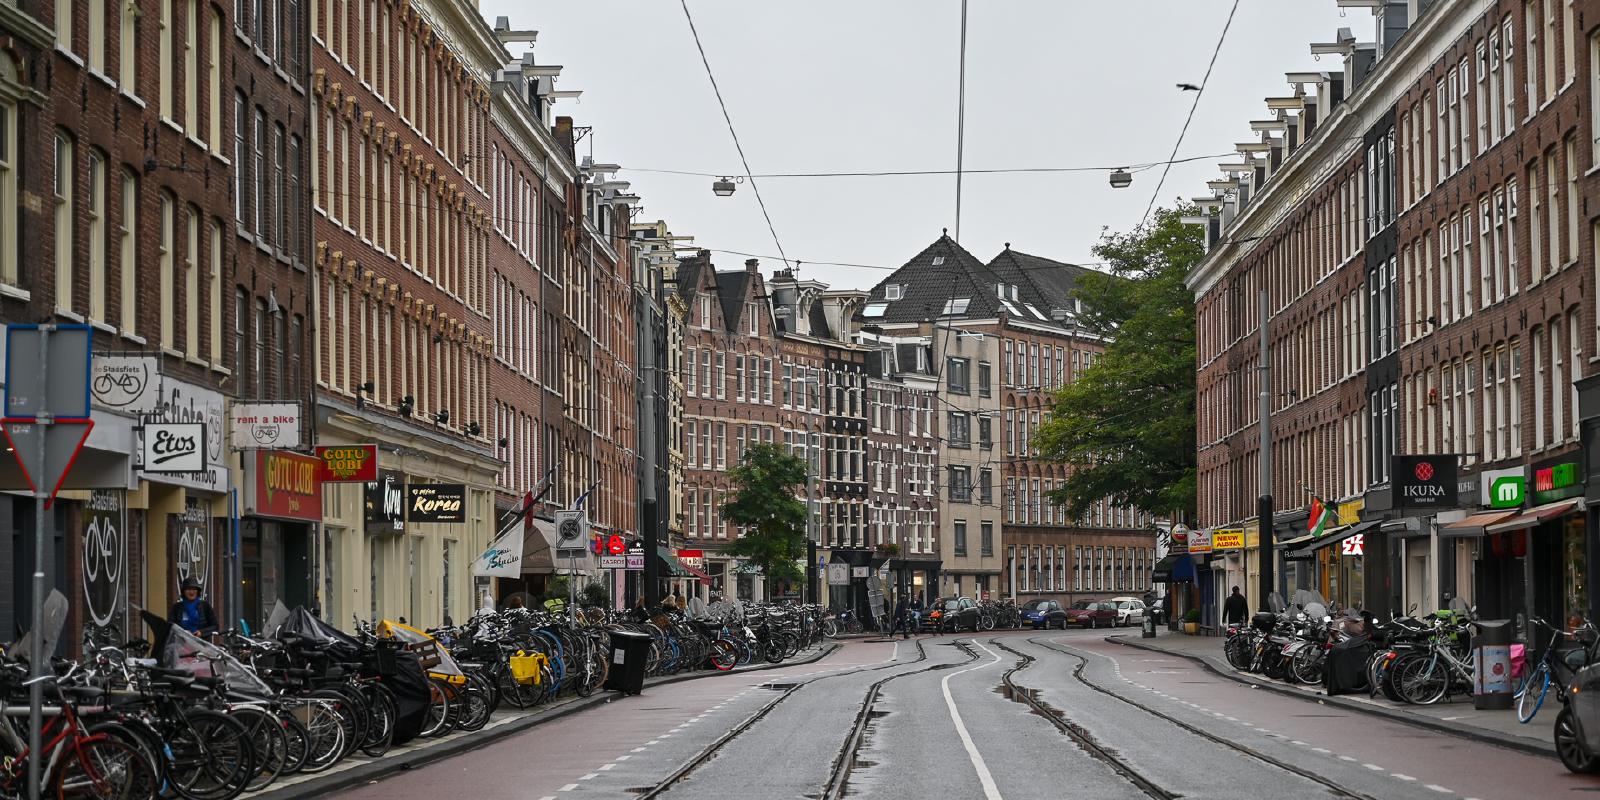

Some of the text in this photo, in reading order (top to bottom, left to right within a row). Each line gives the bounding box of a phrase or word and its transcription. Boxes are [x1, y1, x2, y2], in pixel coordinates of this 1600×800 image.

[237, 415, 294, 424] rent a bike
[152, 429, 196, 455] Etos
[324, 448, 365, 460] GOTU
[327, 460, 362, 470] LOBI
[268, 455, 314, 496] GOTU LOBI
[1403, 485, 1446, 496] IKURA
[413, 496, 461, 514] Korea
